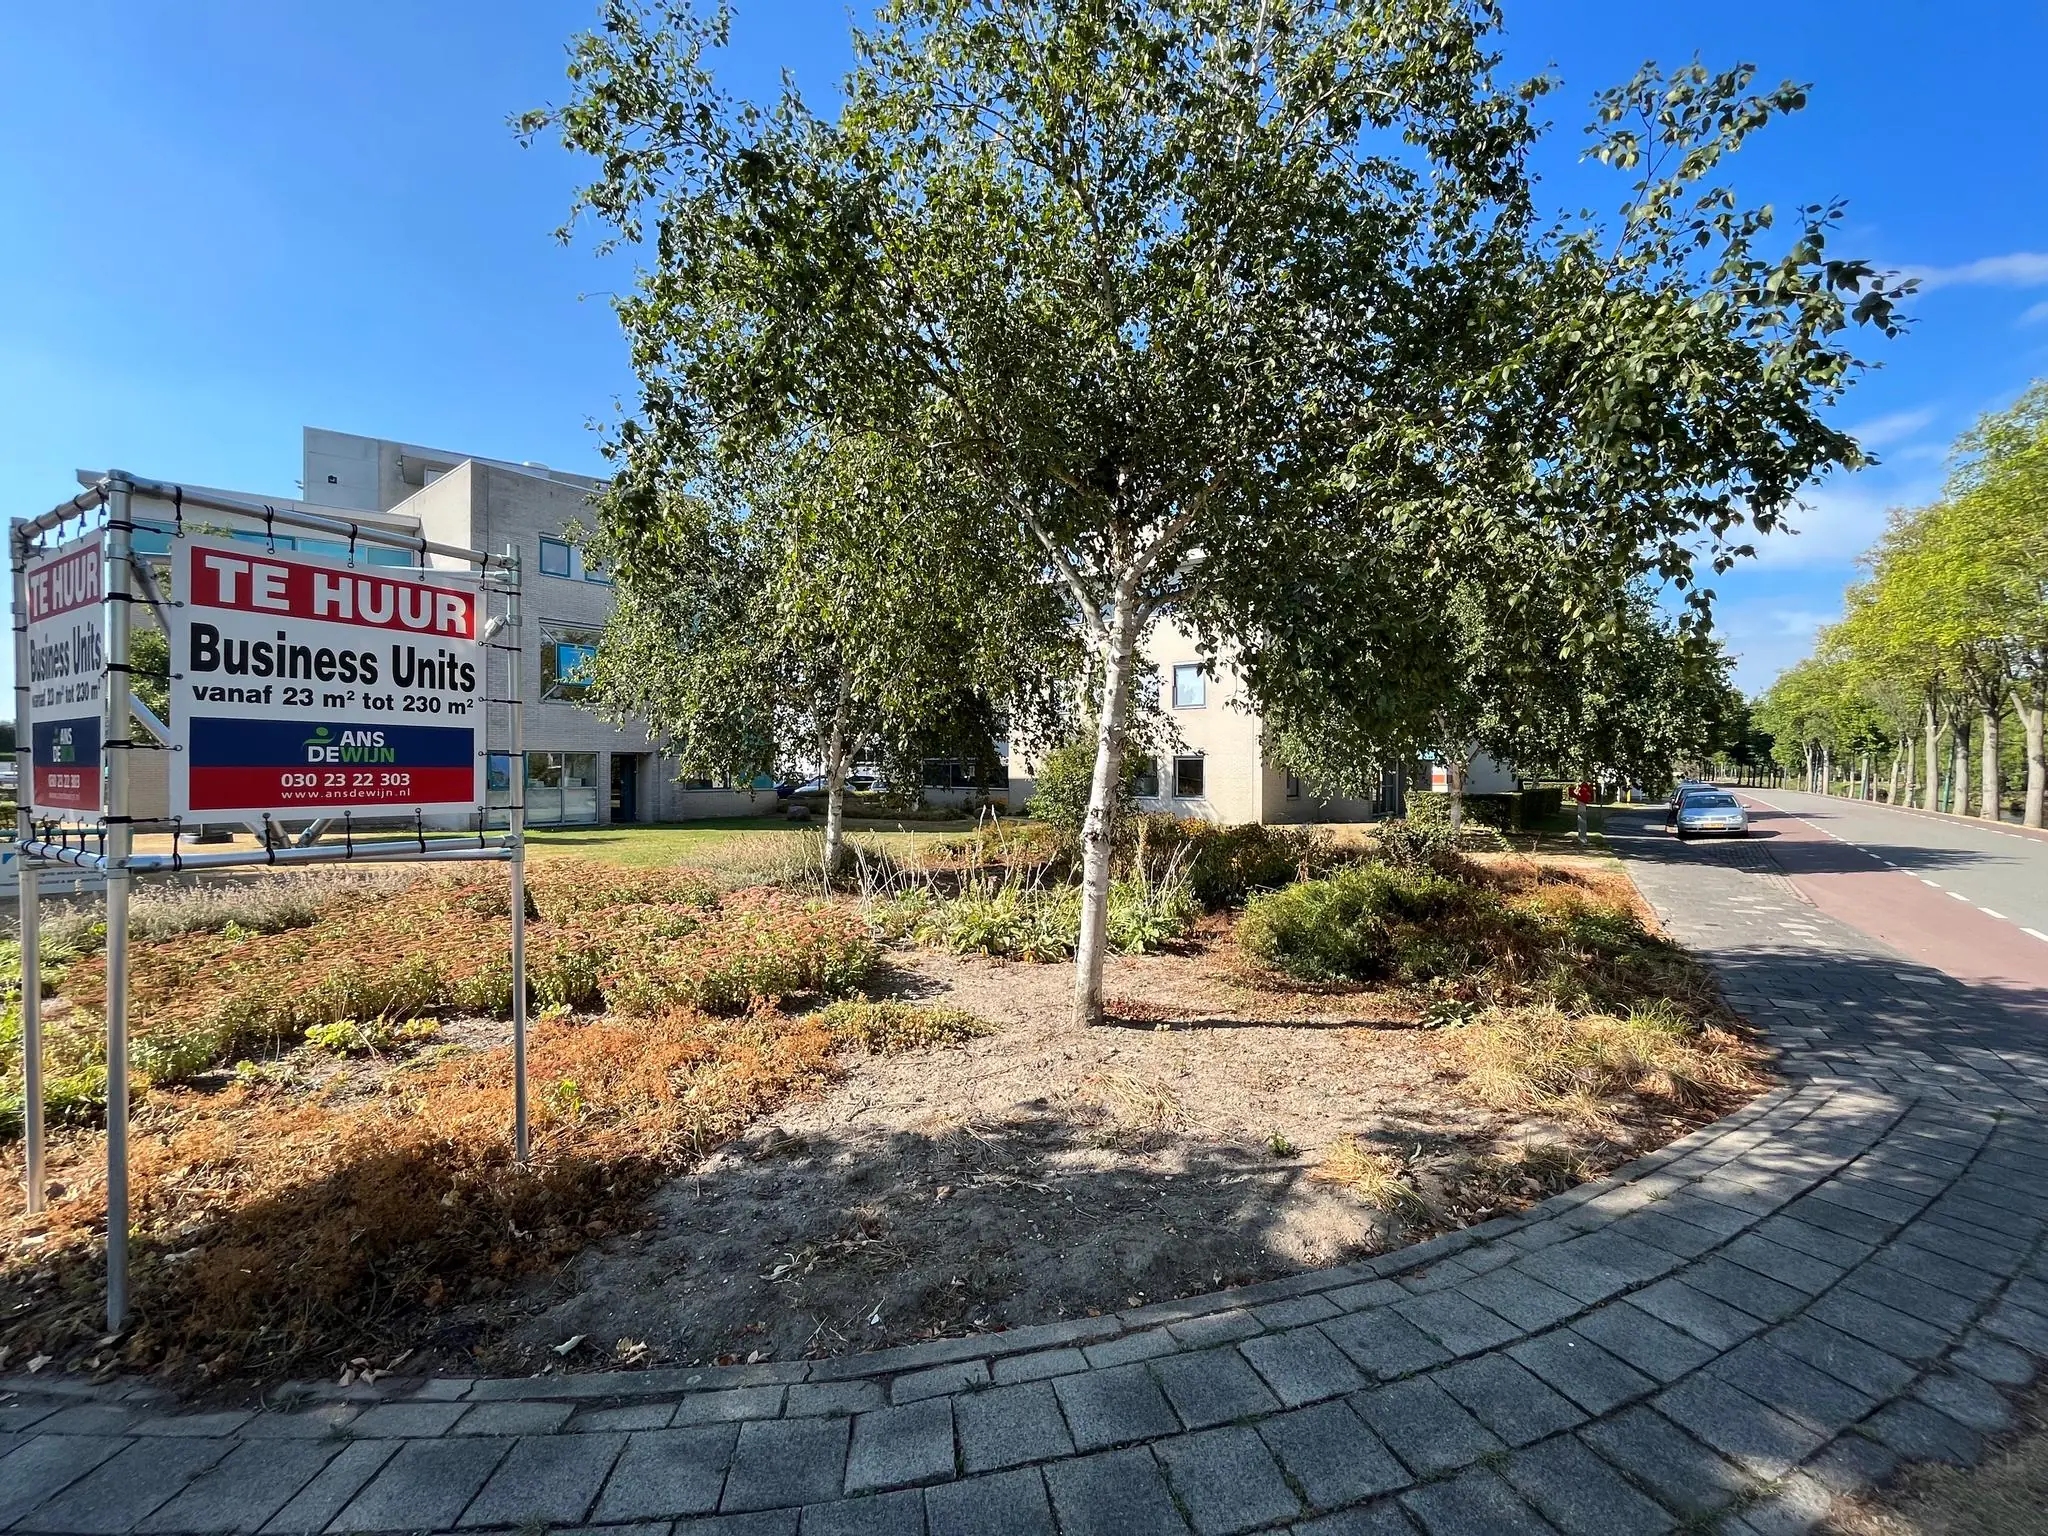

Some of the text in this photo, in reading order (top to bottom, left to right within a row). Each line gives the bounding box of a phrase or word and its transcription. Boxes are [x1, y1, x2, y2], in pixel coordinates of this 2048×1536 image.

[30, 551, 98, 617] TE HUUR
[205, 554, 468, 634] TE HUUR
[30, 621, 101, 682] Business Units
[190, 621, 476, 692] Business Units
[192, 685, 474, 714] vanaf 23 m² tot 230 m²
[340, 730, 385, 747] ANS
[281, 773, 410, 787] 030 23 22 303
[281, 788, 411, 799] www.ansdewijn.nl
